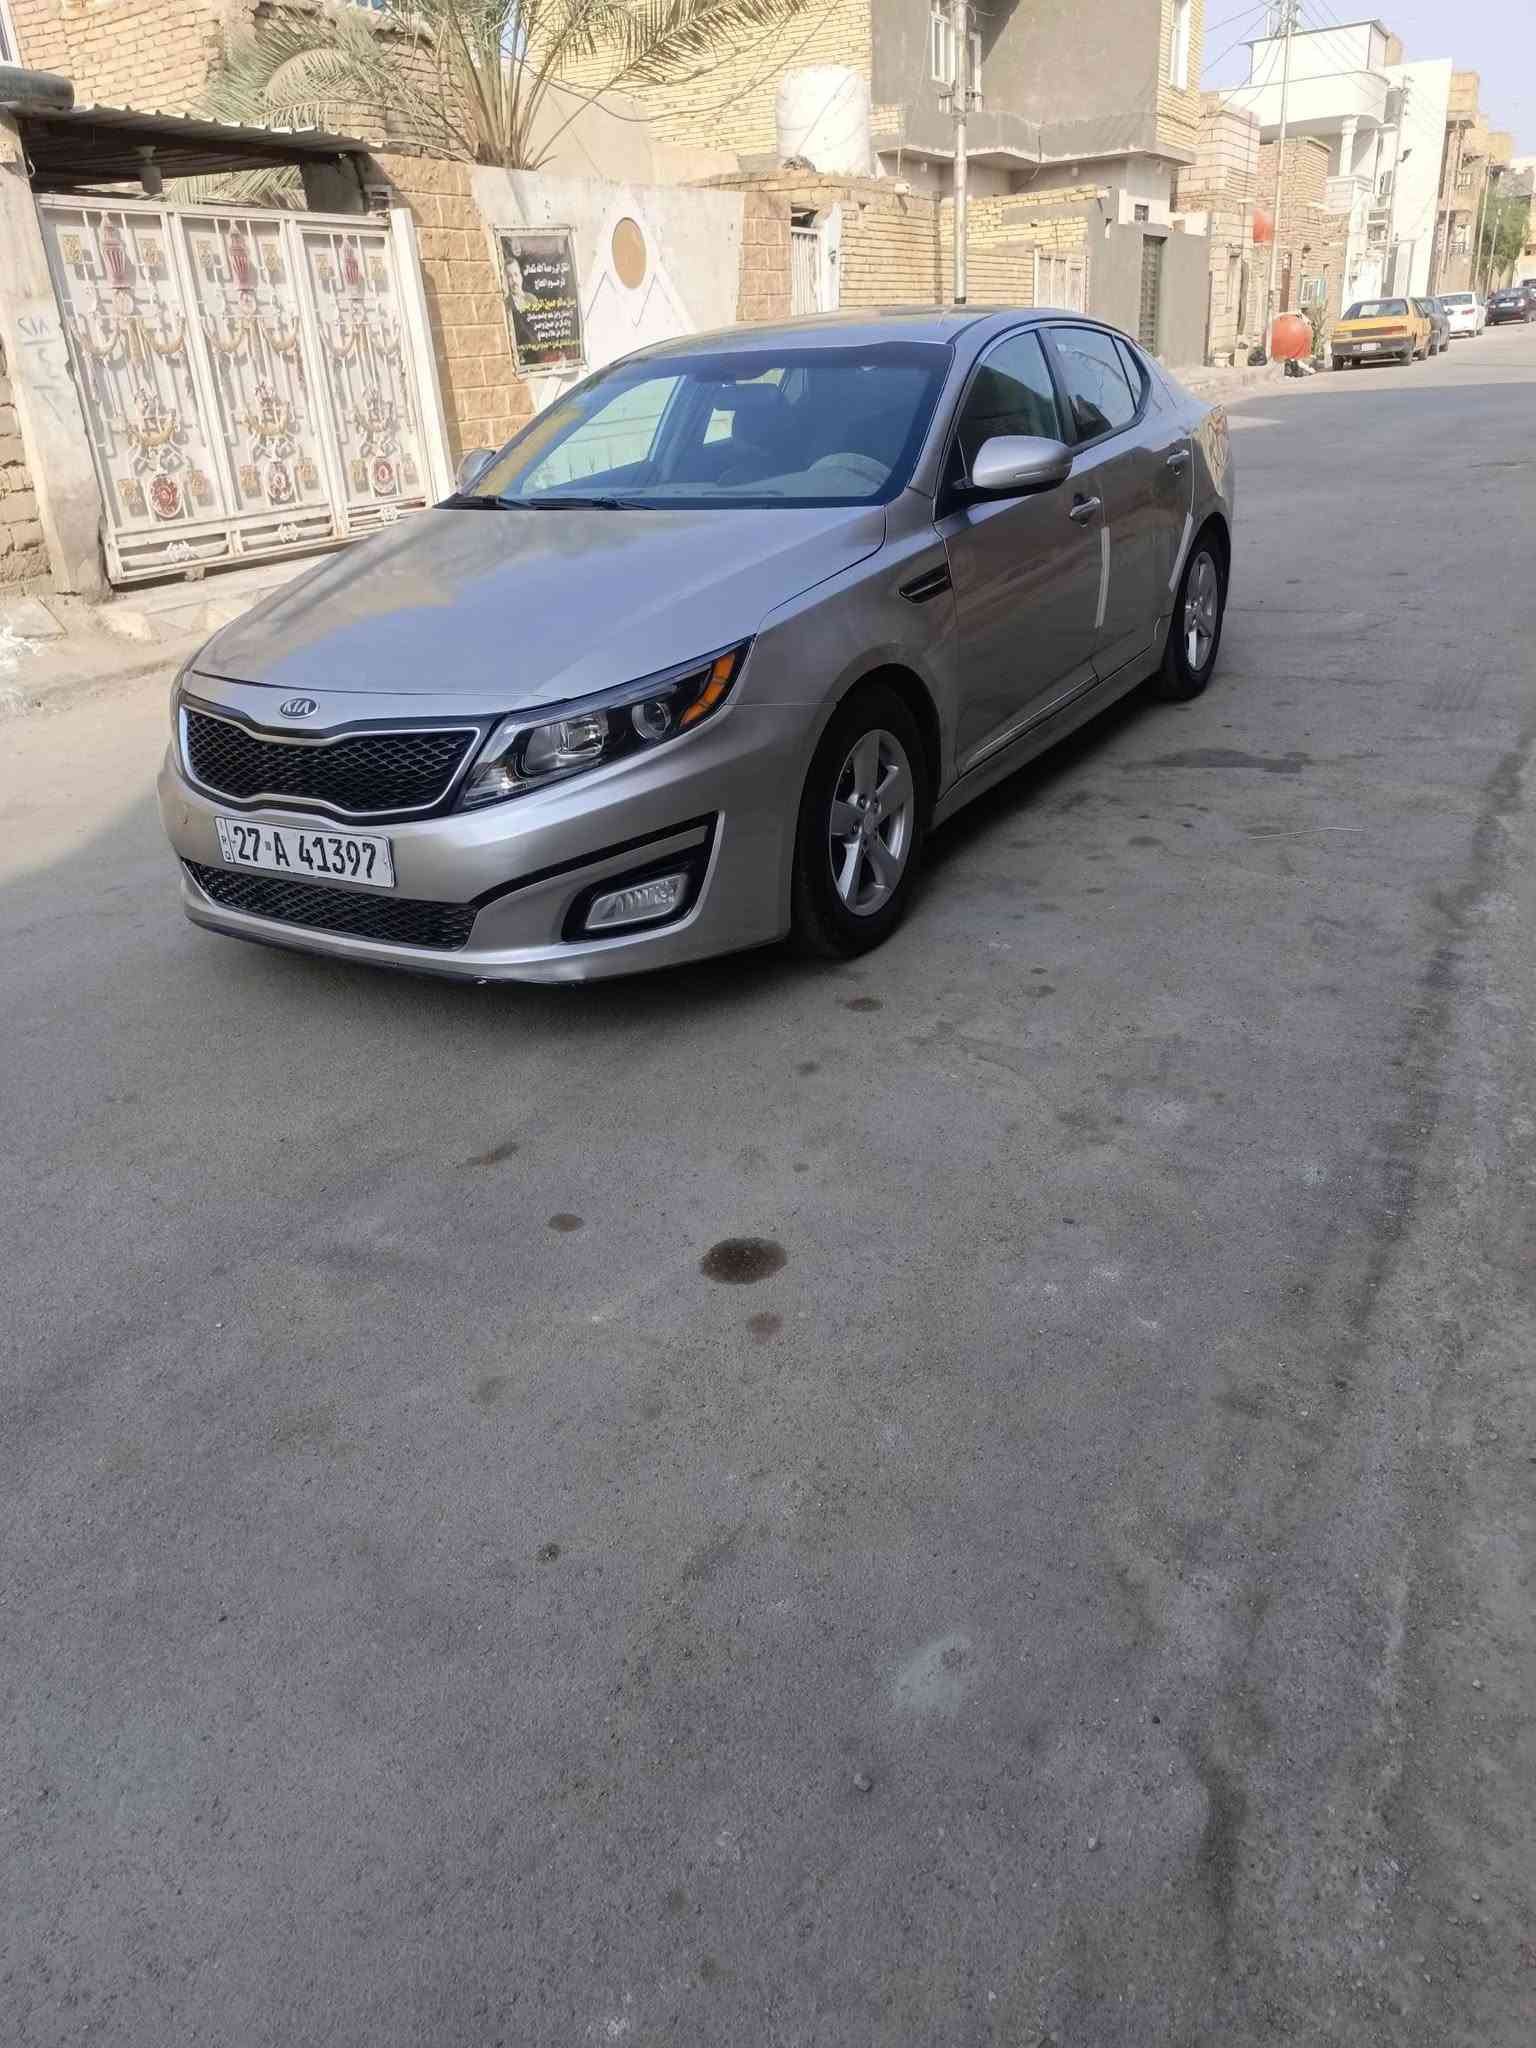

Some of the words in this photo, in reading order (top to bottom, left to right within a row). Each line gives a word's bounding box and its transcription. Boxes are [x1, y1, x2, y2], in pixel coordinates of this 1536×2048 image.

[233, 825, 261, 862] 27
[273, 831, 291, 867] A
[298, 835, 377, 879] 41397
